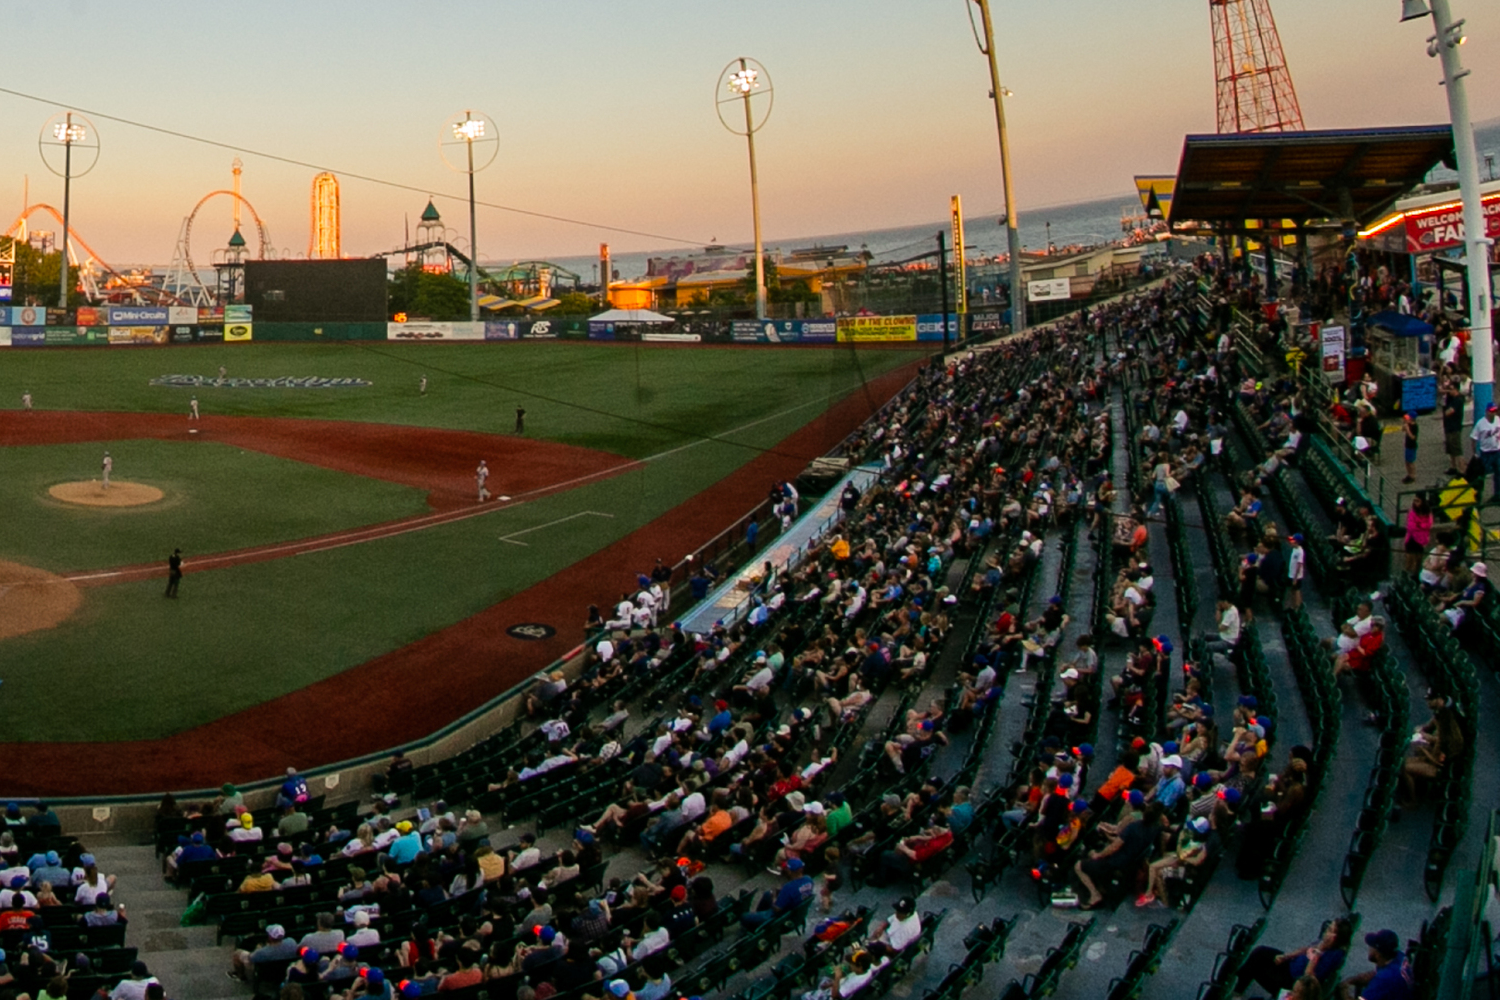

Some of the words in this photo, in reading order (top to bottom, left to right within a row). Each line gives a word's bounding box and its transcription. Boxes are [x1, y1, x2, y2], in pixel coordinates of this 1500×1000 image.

[1416, 211, 1464, 229] WELCOM
[123, 311, 166, 320] Mini-Circuits
[868, 318, 881, 326] THE
[918, 321, 957, 332] GEICO
